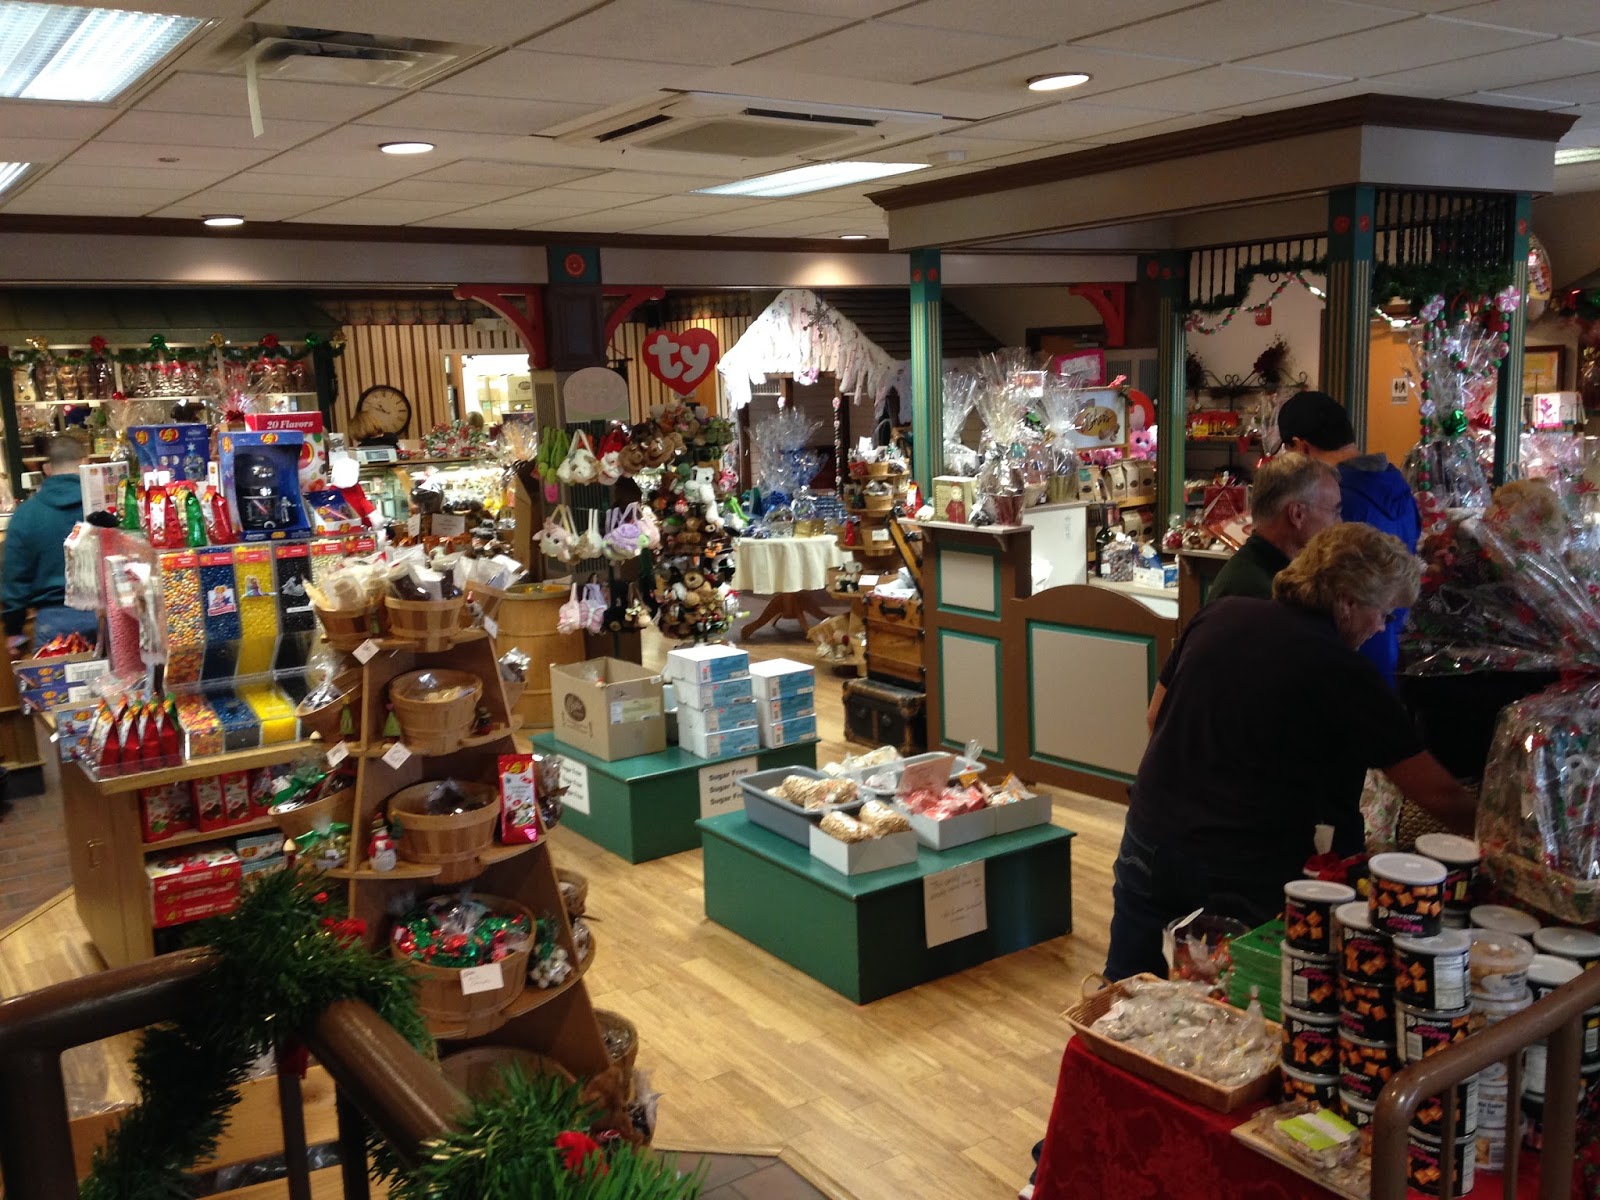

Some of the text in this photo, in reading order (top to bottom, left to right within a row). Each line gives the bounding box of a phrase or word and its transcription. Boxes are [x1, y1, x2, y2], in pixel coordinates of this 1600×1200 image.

[648, 334, 711, 383] ty
[266, 419, 314, 430] 20 Flavors
[708, 768, 749, 782] Sugar Free
[709, 784, 731, 794] Sugar
[710, 796, 732, 806] Sugar
